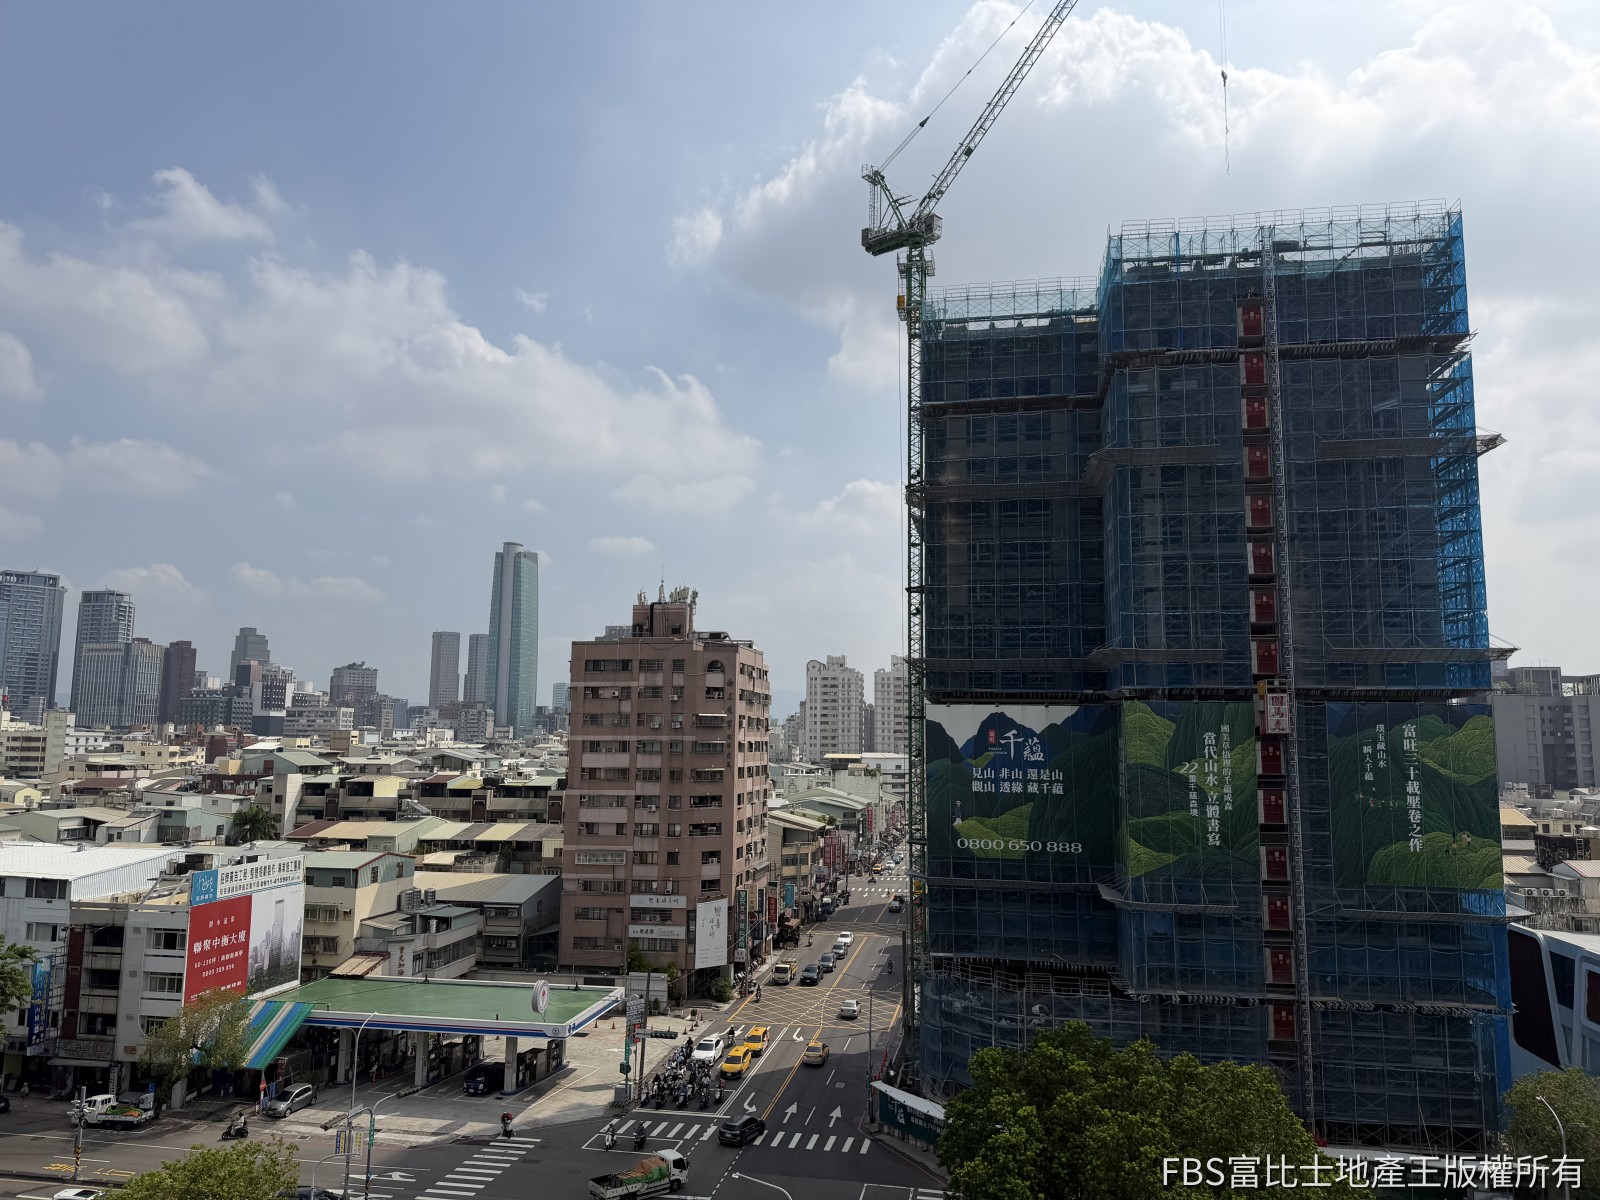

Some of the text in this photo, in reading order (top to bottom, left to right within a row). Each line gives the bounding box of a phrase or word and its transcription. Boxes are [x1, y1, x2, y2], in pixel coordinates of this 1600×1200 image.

[972, 767, 1063, 781] 見山 非山 還是山
[972, 781, 995, 793] 觀山
[1203, 732, 1220, 846] 當代山水 立體書寫
[1402, 724, 1423, 852] 富旺三十載壓卷之作
[957, 838, 1082, 854] 0800 650 888
